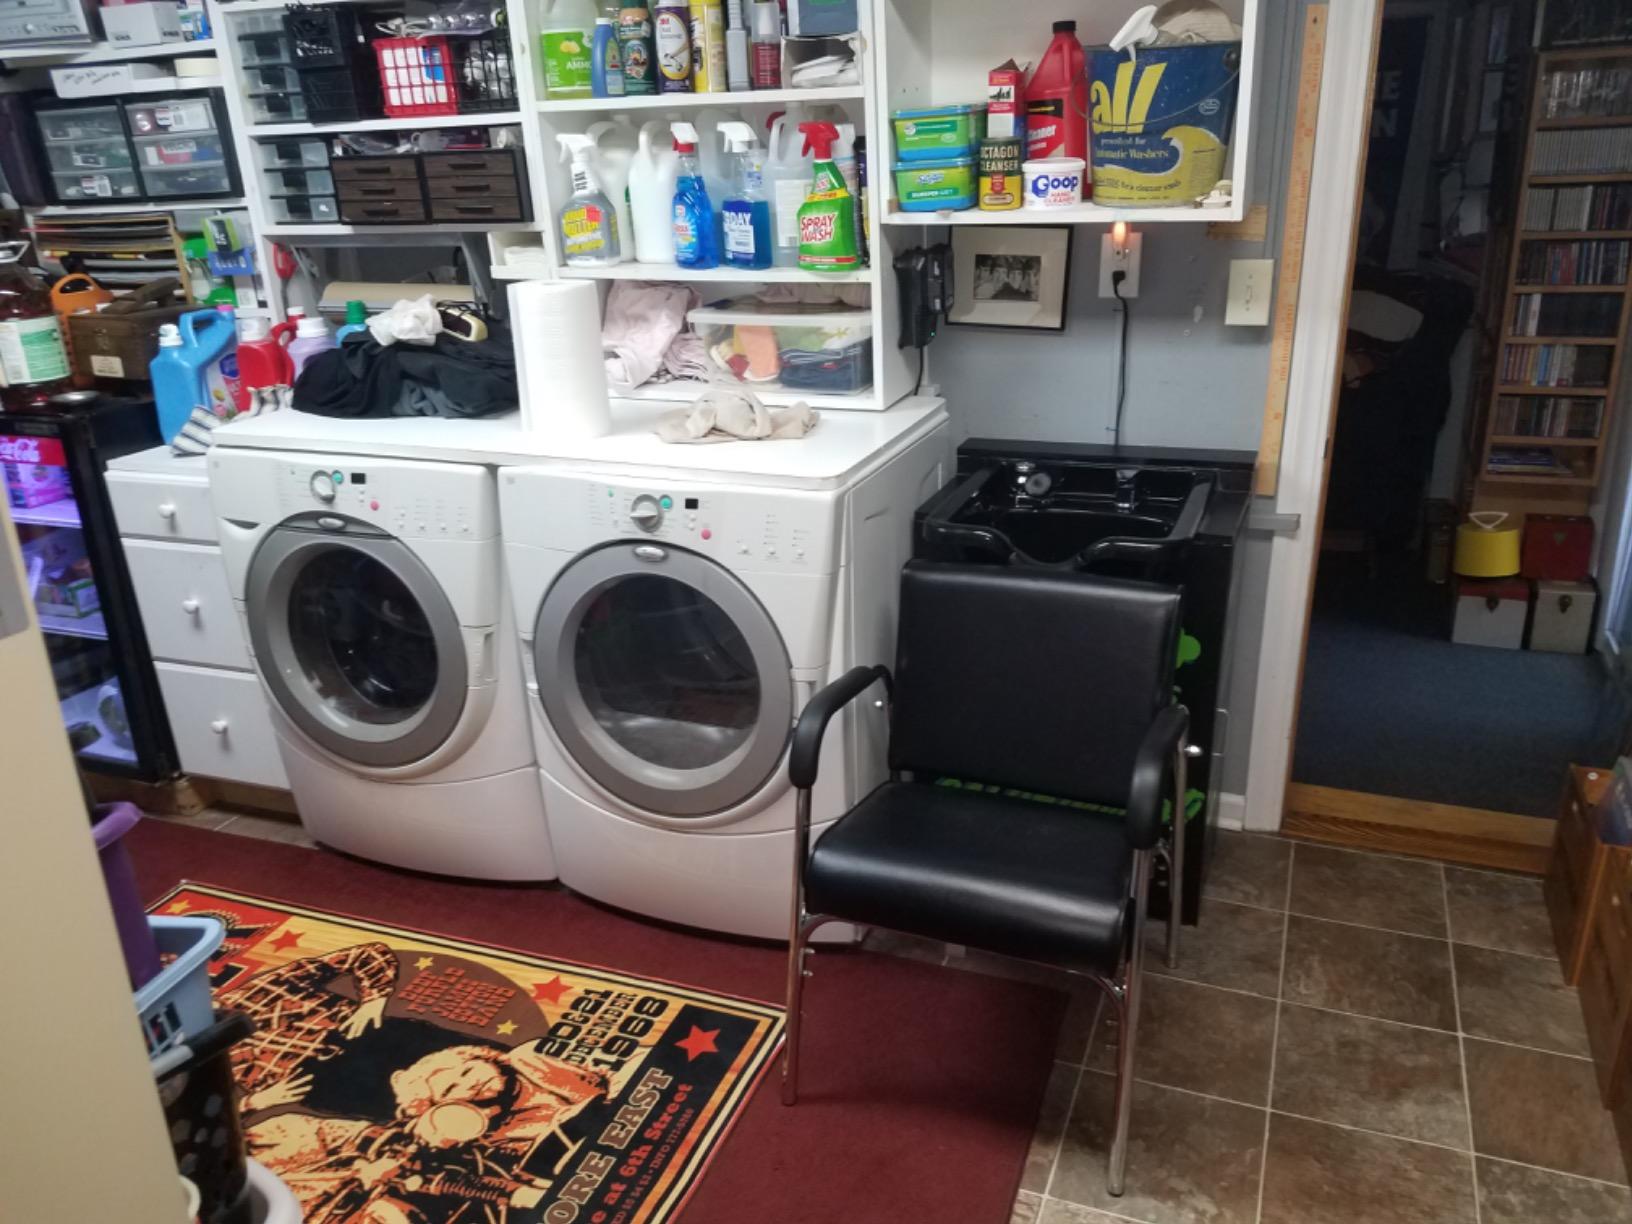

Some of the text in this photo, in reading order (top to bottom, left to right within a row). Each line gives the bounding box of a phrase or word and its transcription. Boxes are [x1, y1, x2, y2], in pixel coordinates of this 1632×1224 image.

[1090, 61, 1168, 135] all
[981, 145, 1019, 159] OCTAGON
[1032, 175, 1078, 198] Goop
[801, 213, 835, 230] SPRAY
[562, 992, 638, 1064] DECEMBER
[592, 996, 669, 1071] 1968
[597, 1067, 673, 1149] EAST
[604, 1182, 627, 1205] at
[618, 1144, 653, 1177] 6th
[644, 1083, 693, 1140] Street
